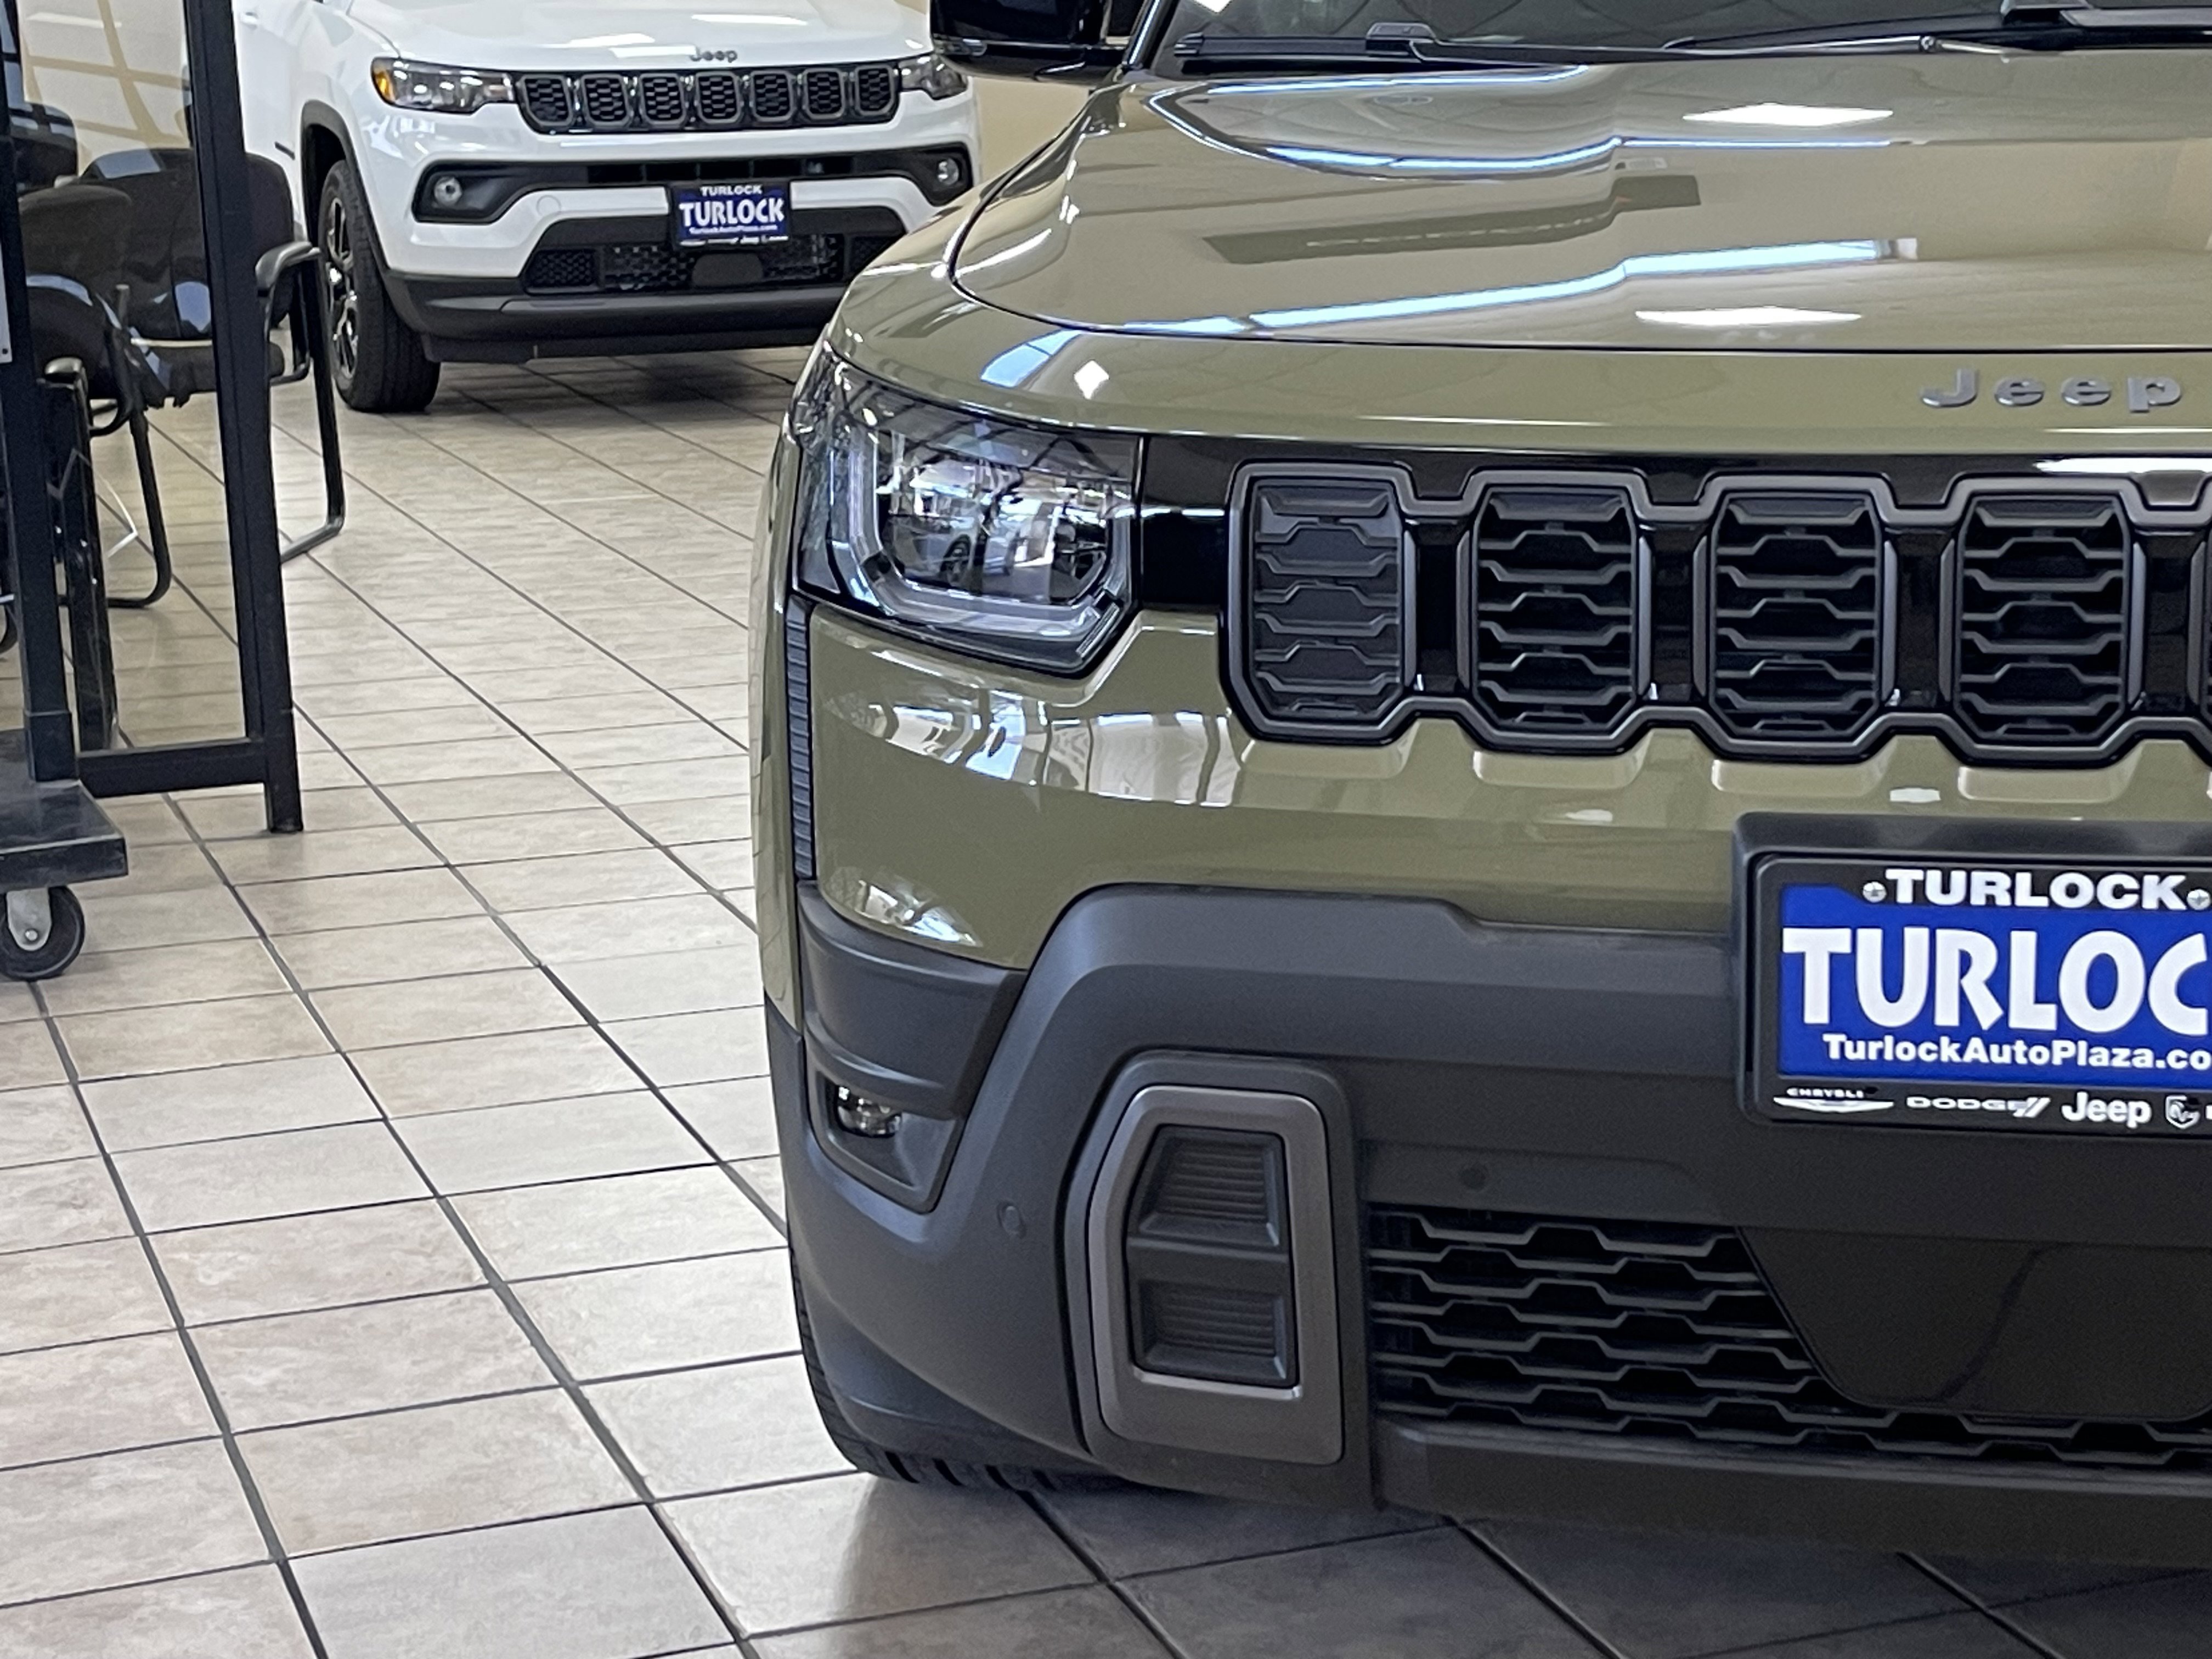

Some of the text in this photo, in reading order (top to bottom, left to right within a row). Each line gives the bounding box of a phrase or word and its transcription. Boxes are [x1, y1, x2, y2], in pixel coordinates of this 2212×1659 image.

[689, 46, 738, 63] Jeep
[700, 184, 763, 196] TURLOCK
[679, 198, 785, 227] TURLOCK
[1921, 368, 2182, 414] Jeep
[1885, 869, 2187, 911] TURLOCK
[1782, 926, 2208, 1036] TURLOC
[1906, 1091, 2152, 1129] DODGE Jeep
